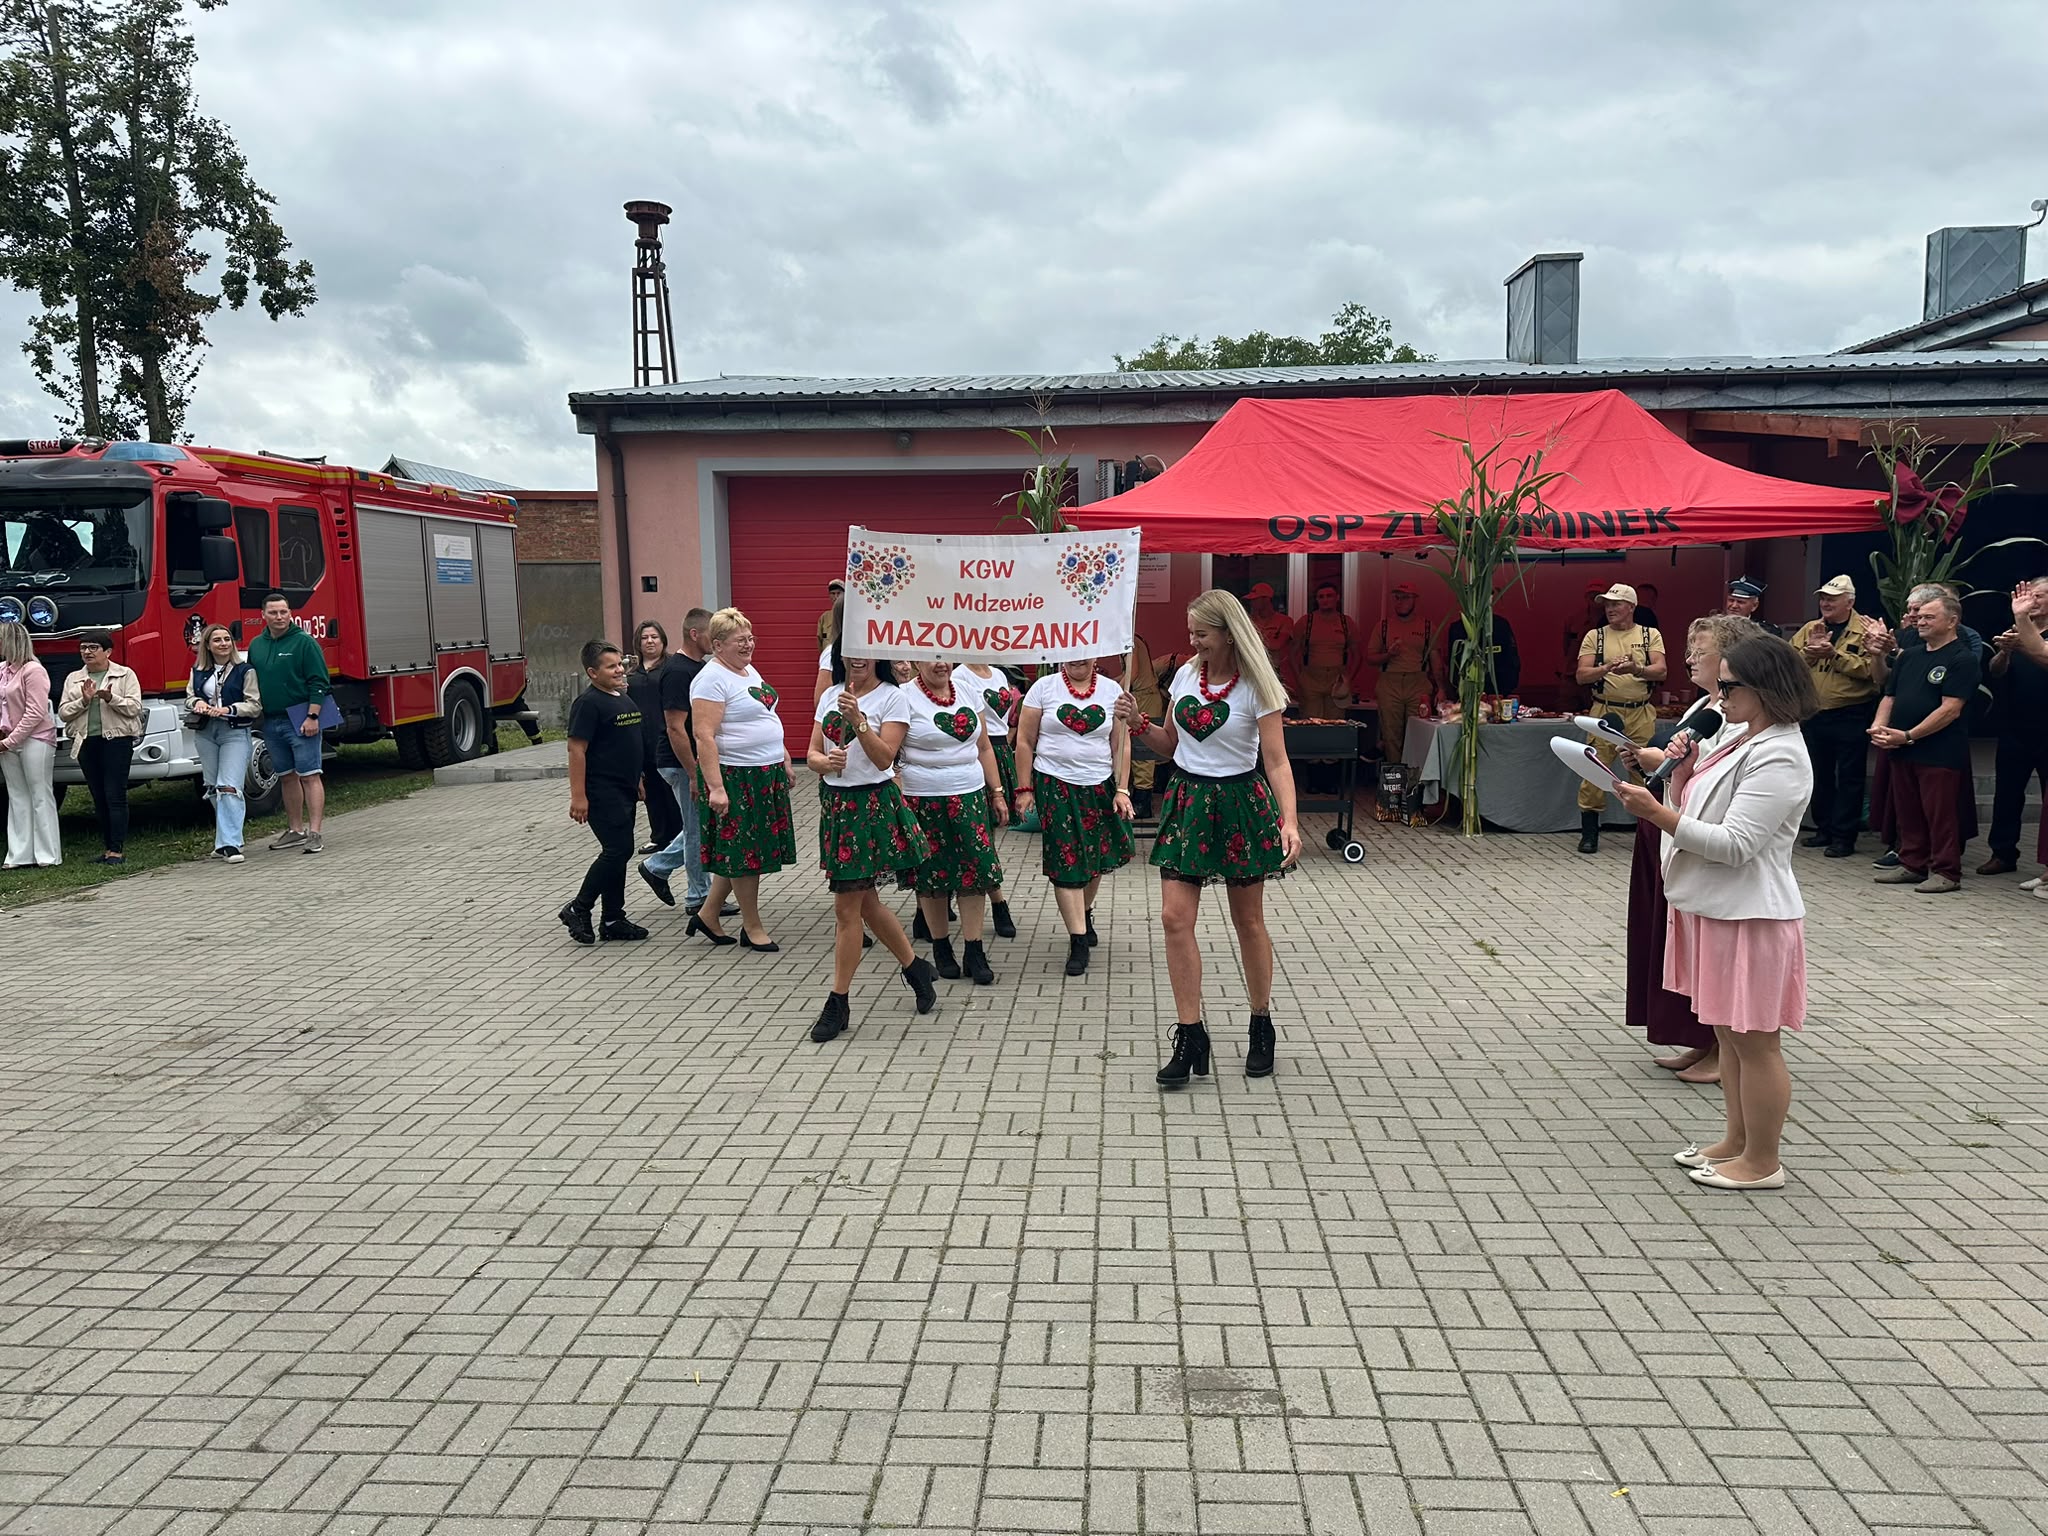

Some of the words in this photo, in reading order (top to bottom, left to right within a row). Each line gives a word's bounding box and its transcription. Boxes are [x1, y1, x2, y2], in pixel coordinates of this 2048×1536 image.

[1268, 514, 1364, 542] OSP
[959, 559, 1015, 579] KGW
[926, 595, 945, 609] w
[953, 592, 1045, 612] Mdzewie
[867, 619, 1100, 651] MAZOWSZANKI
